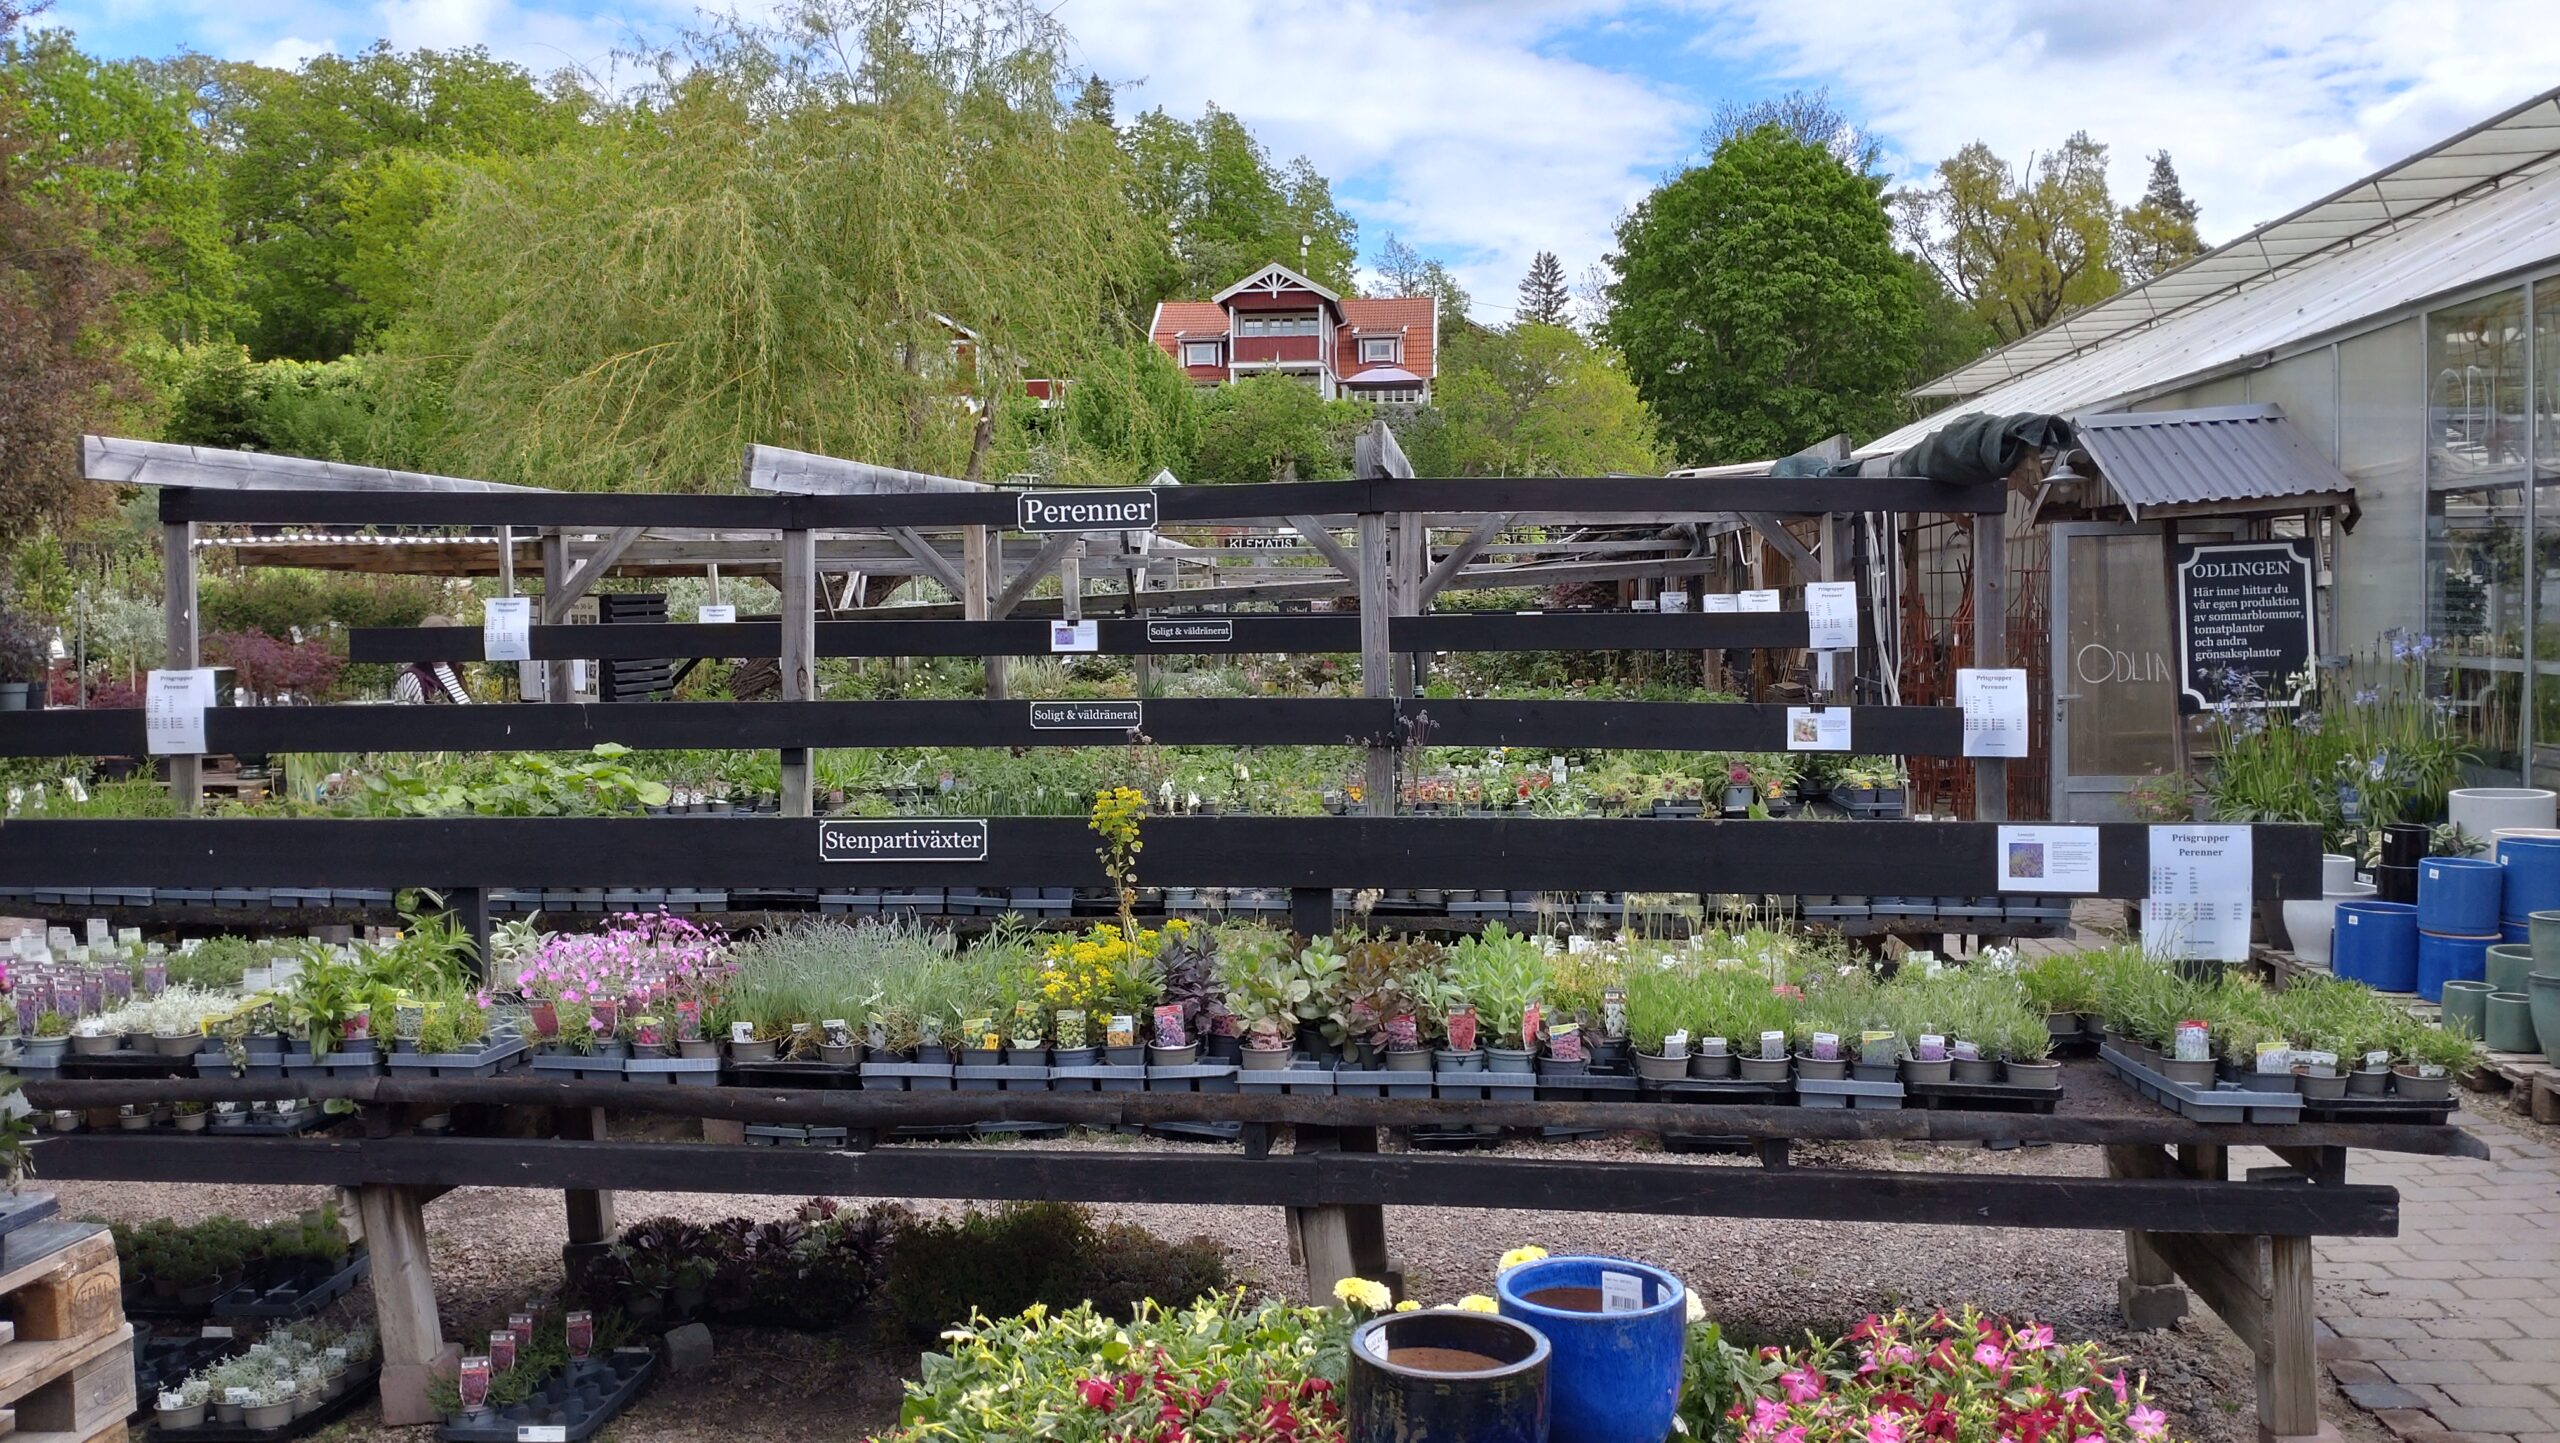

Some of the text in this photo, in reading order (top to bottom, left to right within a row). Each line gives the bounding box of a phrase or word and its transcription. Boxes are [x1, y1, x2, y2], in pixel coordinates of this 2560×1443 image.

[1024, 499, 1152, 524] Perenner
[2192, 560, 2291, 578] ODLINGEN
[2193, 583, 2289, 597] Här inne hittar du
[2193, 596, 2300, 611] vår egen produktion
[2193, 609, 2305, 622] av sommarblommor,
[1150, 626, 1229, 637] Soligt & väldränerat
[2194, 623, 2265, 636] tomatplantor
[2194, 635, 2248, 647] och andra
[2195, 647, 2282, 662] grönsaksplantor
[1034, 708, 1138, 722] Soligt & väldränerat
[825, 830, 982, 854] Stenpartiväxter
[2172, 833, 2230, 844] Prisgrupper
[2178, 848, 2224, 857] Perenner
